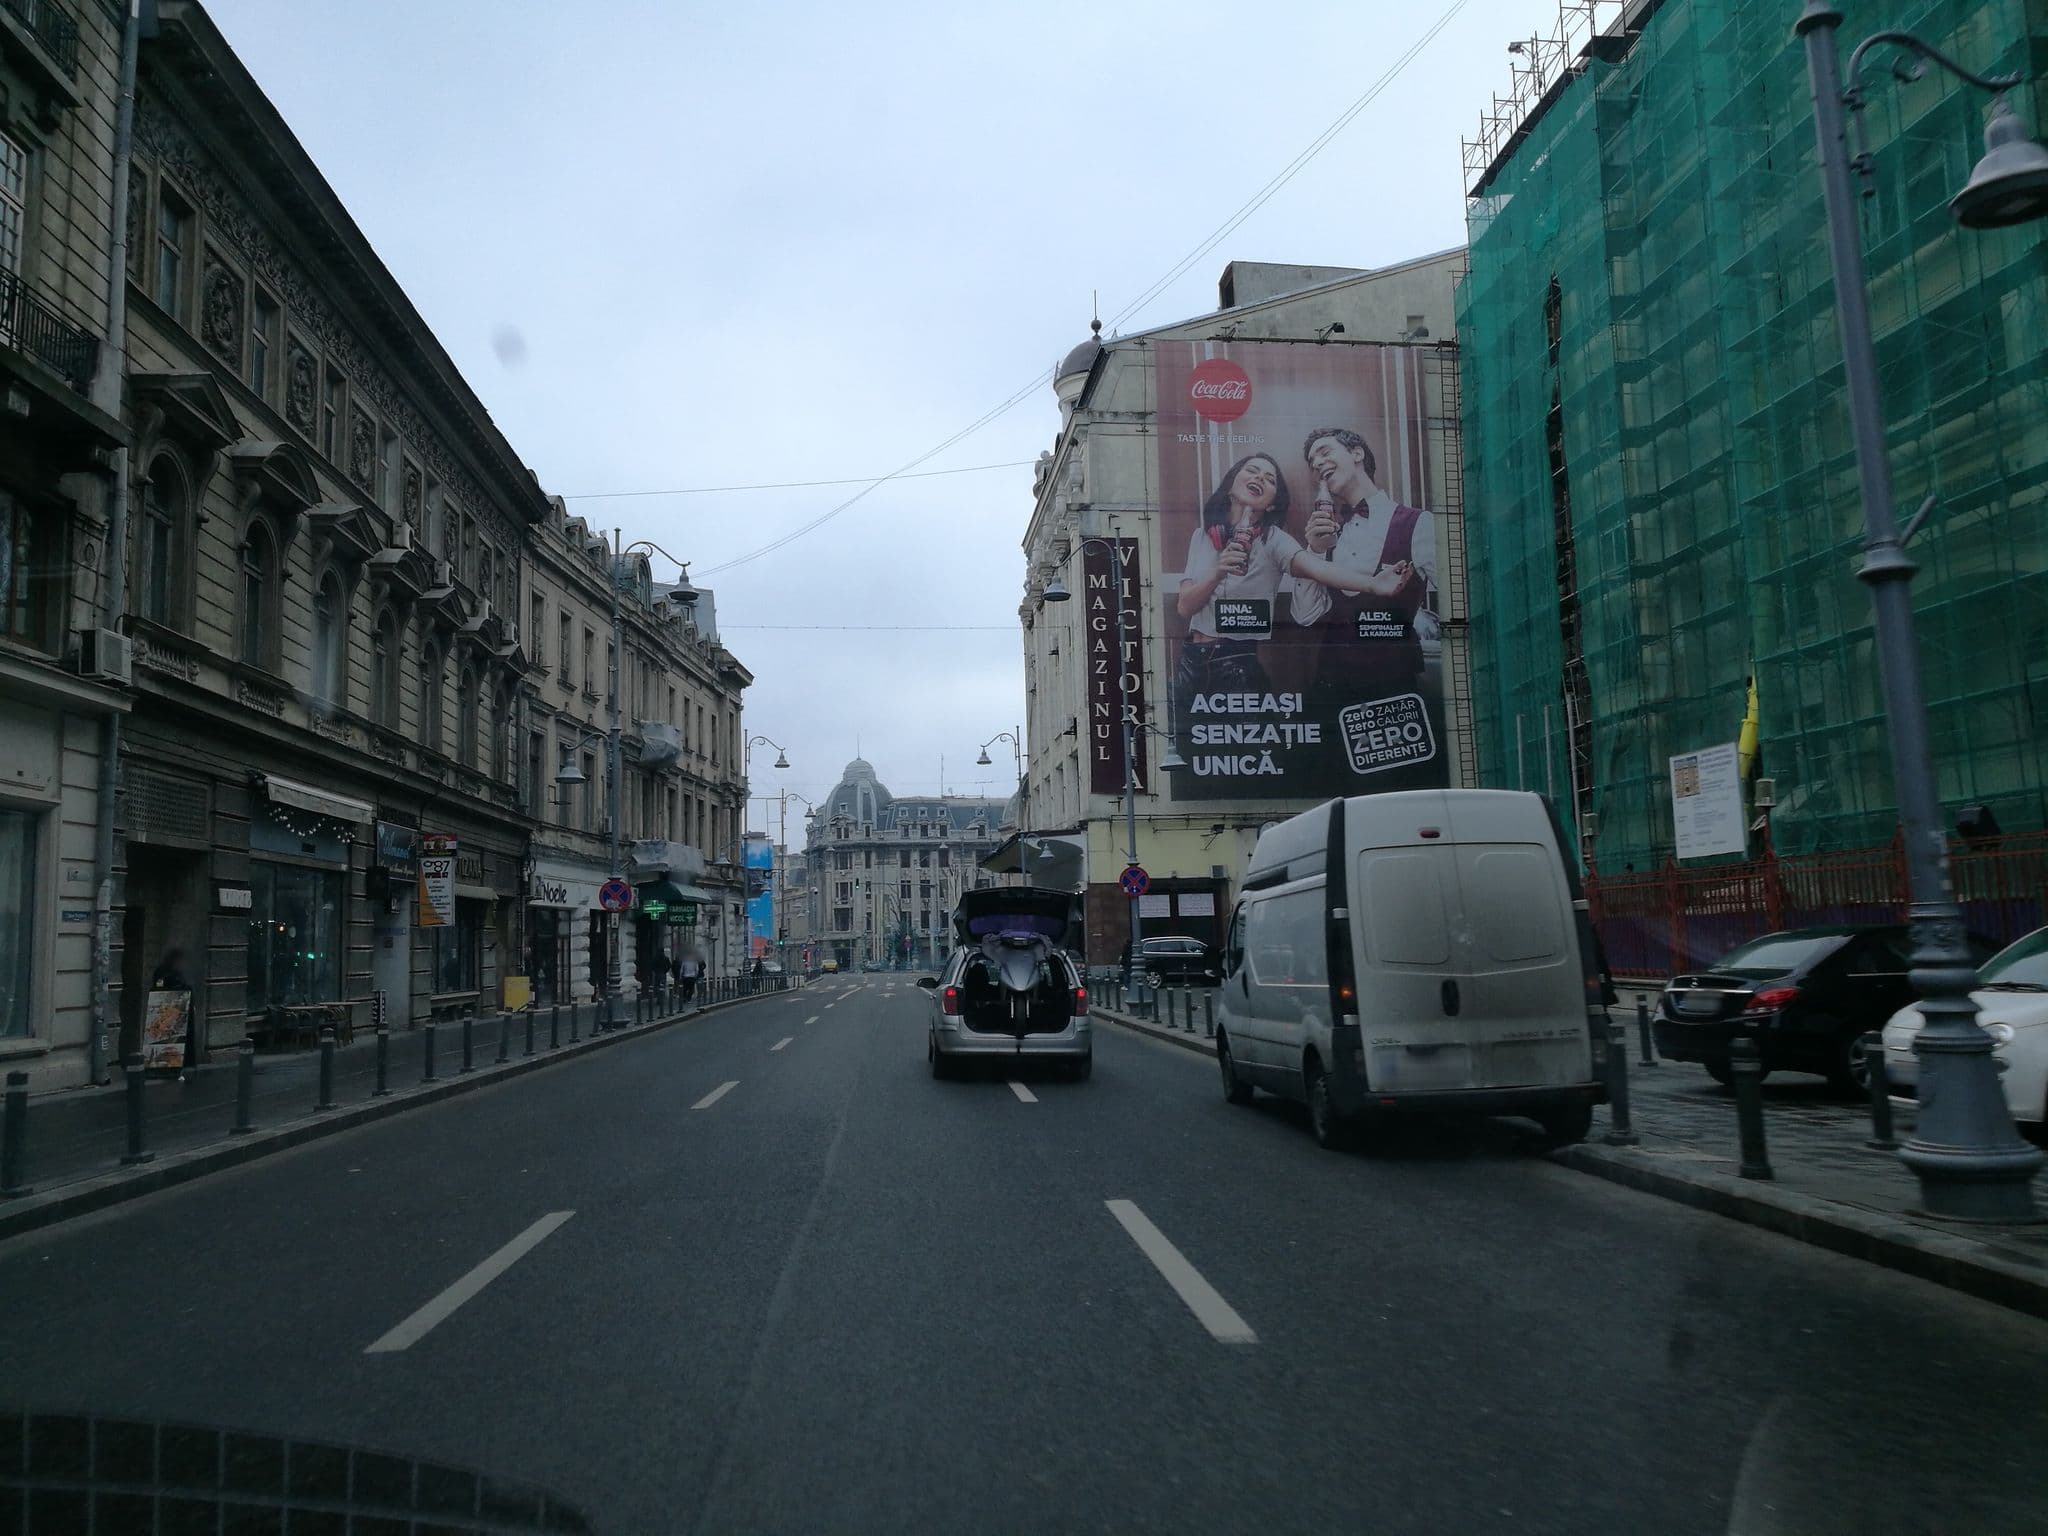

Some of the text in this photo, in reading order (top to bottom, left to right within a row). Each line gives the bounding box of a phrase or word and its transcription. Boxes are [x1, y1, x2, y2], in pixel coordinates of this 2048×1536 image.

[1192, 379, 1248, 400] Coca-Cola
[1177, 434, 1205, 443] TASTE
[1220, 604, 1252, 613] INNA:
[1358, 612, 1391, 621] ALEX:
[1221, 616, 1236, 626] 26
[1088, 574, 1111, 760] MAGAZINUL
[1190, 692, 1303, 719] ACEEAȘI
[1345, 700, 1416, 723] zero ZAHĂR
[1348, 711, 1419, 734] zero CALORII
[1191, 723, 1321, 750] SENZAȚIE
[1350, 722, 1422, 754] ZERO
[1192, 750, 1284, 776] UNICĂ.
[1355, 742, 1427, 766] DIFERENȚE
[543, 881, 567, 904] Noelle
